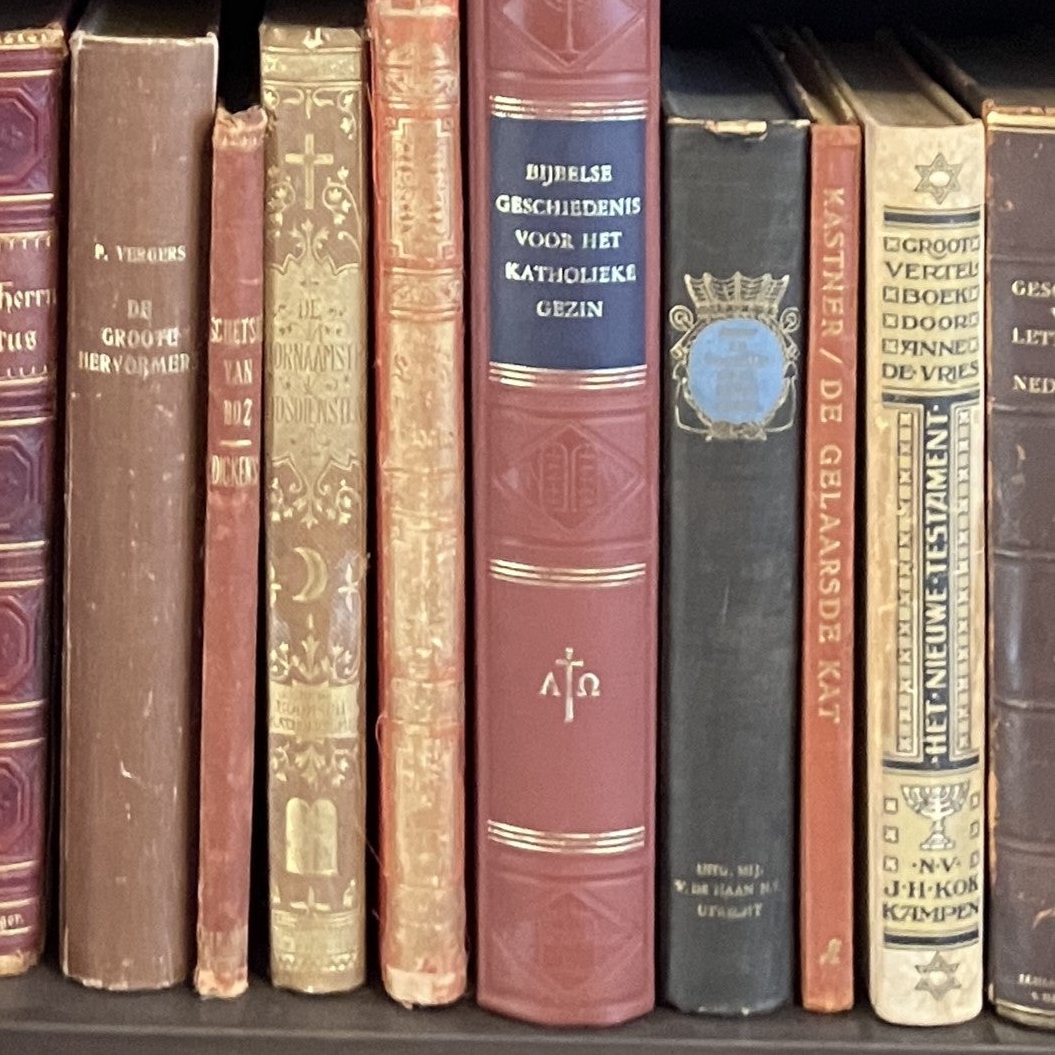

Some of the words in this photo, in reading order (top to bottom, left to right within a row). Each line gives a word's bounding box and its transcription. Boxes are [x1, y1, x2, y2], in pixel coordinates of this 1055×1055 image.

[525, 164, 613, 186] BIJBELSE
[496, 195, 641, 217] GESCHIEDENIS
[514, 229, 575, 249] VOOR
[582, 231, 623, 249] HET
[902, 235, 971, 259] GROOT
[505, 262, 637, 284] KATHOLIEKE
[902, 287, 968, 305] BOEK
[128, 299, 153, 319] DE
[536, 300, 603, 318] GEZIN
[901, 314, 968, 331] DOOR
[101, 327, 181, 347] GROOTE
[900, 339, 967, 356] ANNE
[78, 351, 190, 376] HERVORMER
[223, 359, 253, 384] VAN
[920, 359, 979, 384] VRIES
[819, 377, 842, 424] DE
[925, 418, 949, 574] TESTAMENT
[817, 444, 843, 644] GELAARSDE
[923, 587, 948, 687] NIEUWE
[817, 659, 842, 725] KAT
[924, 700, 947, 756] HET
[882, 900, 979, 924] KAMPEN
